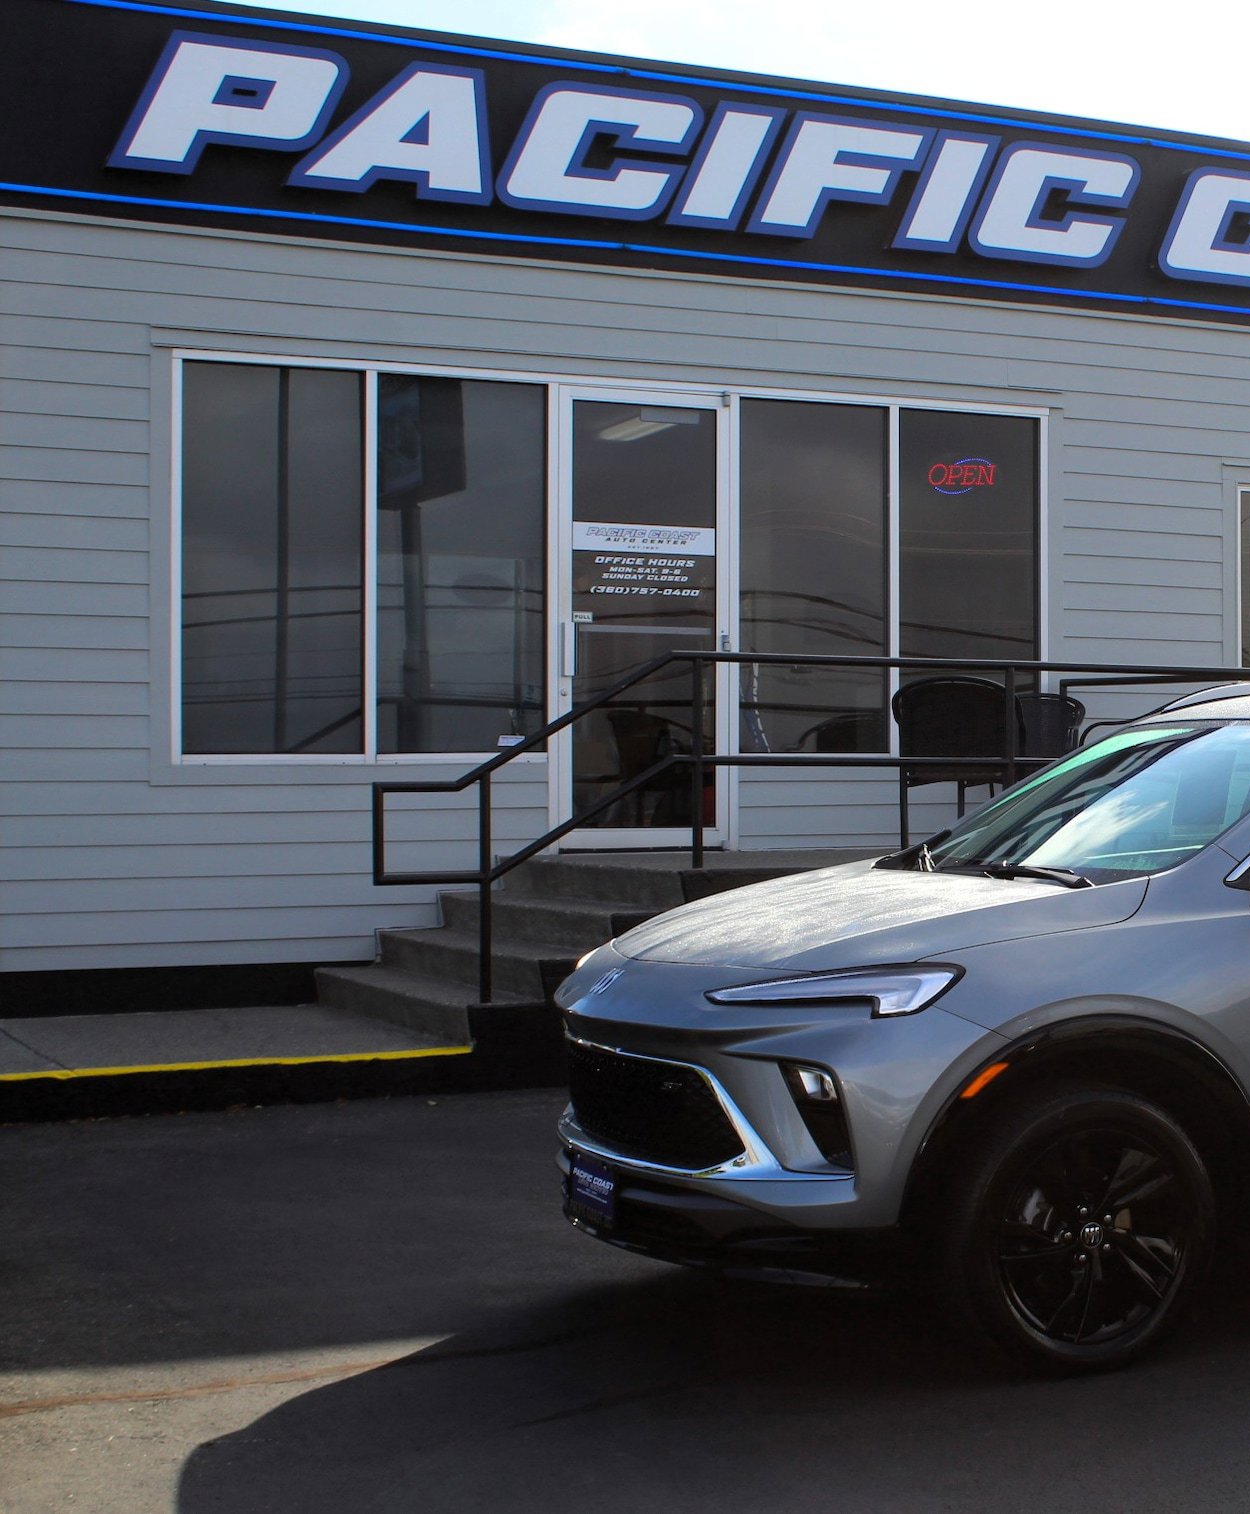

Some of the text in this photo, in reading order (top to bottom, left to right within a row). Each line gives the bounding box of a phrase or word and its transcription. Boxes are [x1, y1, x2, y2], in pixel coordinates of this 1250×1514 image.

[108, 30, 1141, 268] PACIFIC
[928, 463, 996, 486] OPEN
[586, 526, 701, 541] PACIFIC COAST
[594, 556, 696, 568] OFFICE HOURS
[609, 566, 659, 575] MON-SAT.
[646, 574, 689, 582] CLOSED
[590, 585, 701, 598] (360)757-0400
